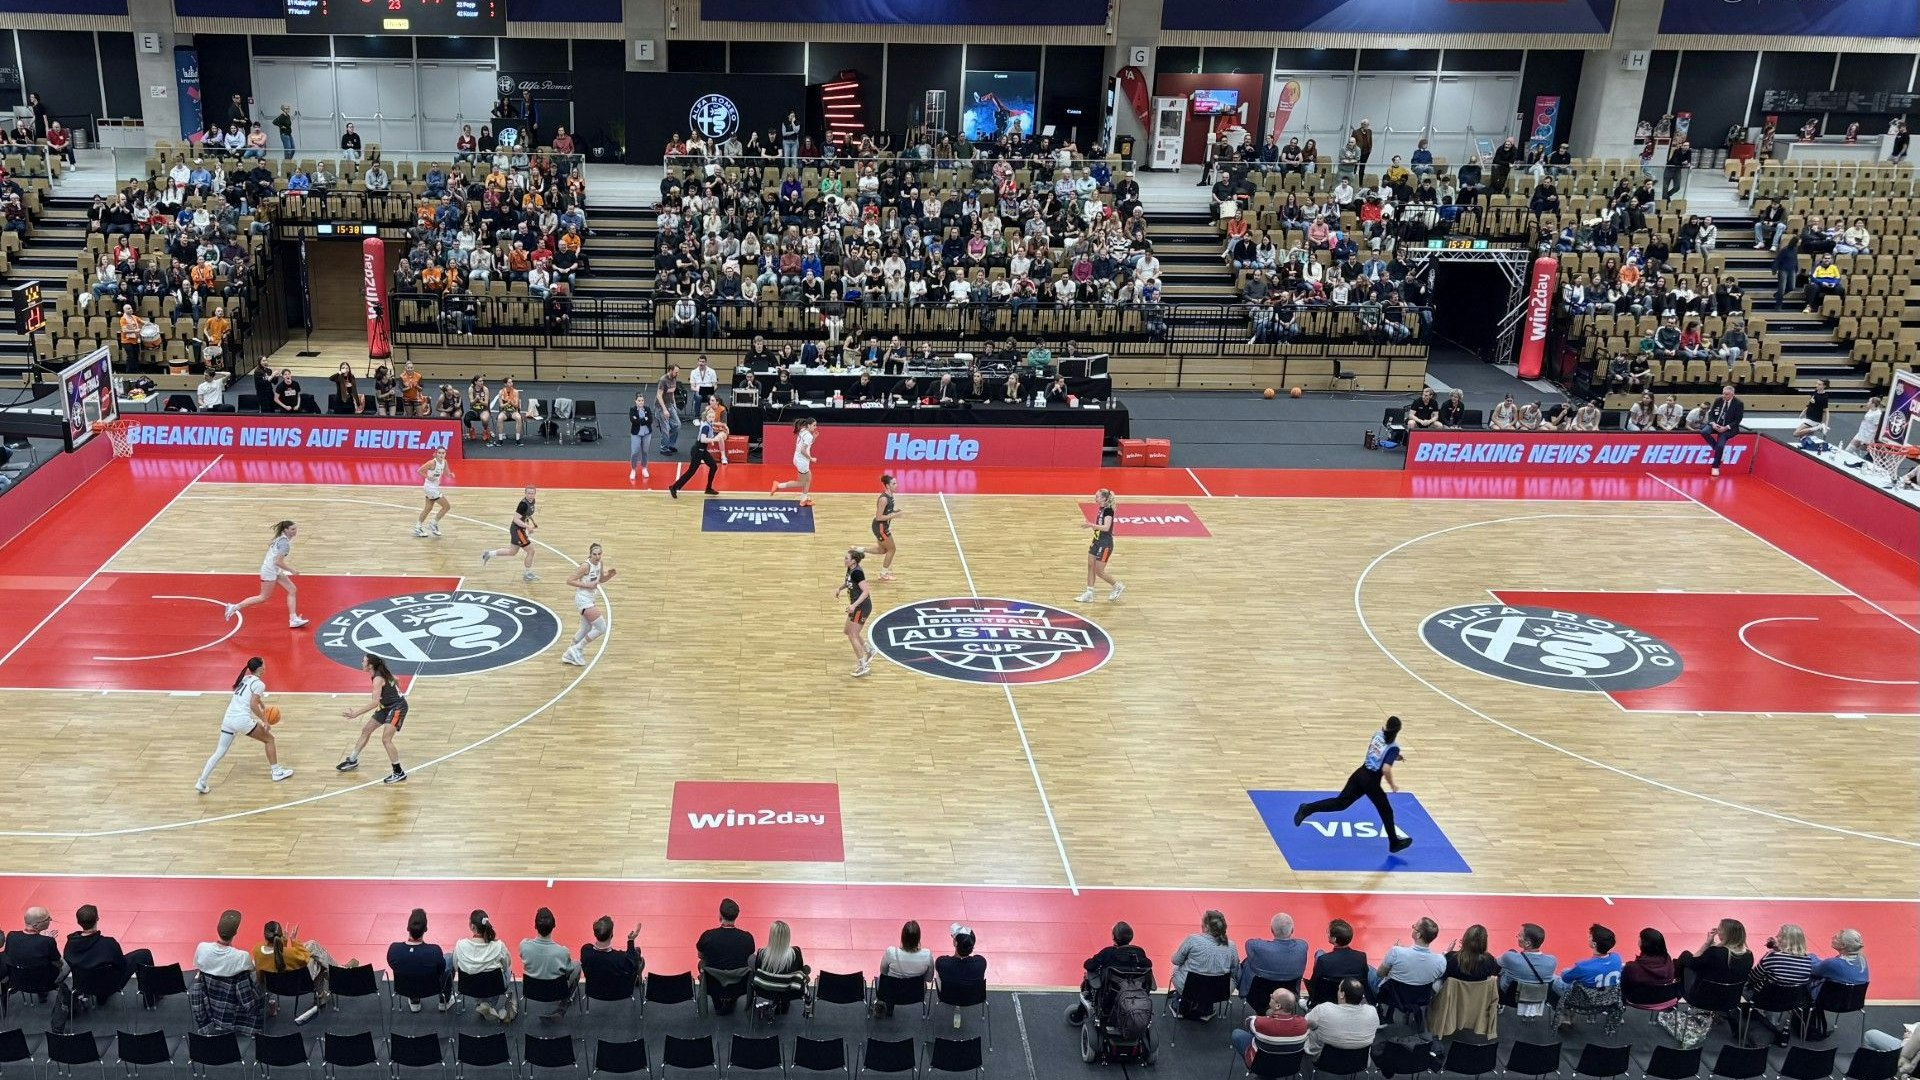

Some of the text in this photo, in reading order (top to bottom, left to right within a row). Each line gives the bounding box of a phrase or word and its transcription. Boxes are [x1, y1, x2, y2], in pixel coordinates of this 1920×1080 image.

[144, 36, 152, 48] E
[641, 44, 648, 56] F
[1135, 50, 1145, 62] G
[1633, 54, 1644, 66] H
[518, 80, 573, 91] Alfa Romeo
[692, 96, 737, 122] ALFA ROMEO
[1449, 240, 1472, 249] 15:38
[364, 253, 380, 320] win2day
[1528, 273, 1551, 342] win2day
[127, 425, 453, 450] BREAKING NEWS AUF HEUTE.AT
[884, 431, 980, 462] Heute
[1414, 442, 1524, 463] BREAKING
[1526, 444, 1594, 464] NEWS
[1593, 444, 1640, 465] AUF
[719, 505, 798, 514] kronehit
[322, 592, 538, 649] ALFA ROMEO
[929, 617, 1041, 626] BASKETBALL
[902, 626, 1080, 644] AUSTRIA
[1437, 606, 1675, 668] ALFA ROMEO
[963, 643, 1023, 653] CUP
[687, 808, 825, 830] win2day
[1594, 970, 1621, 988] 10
